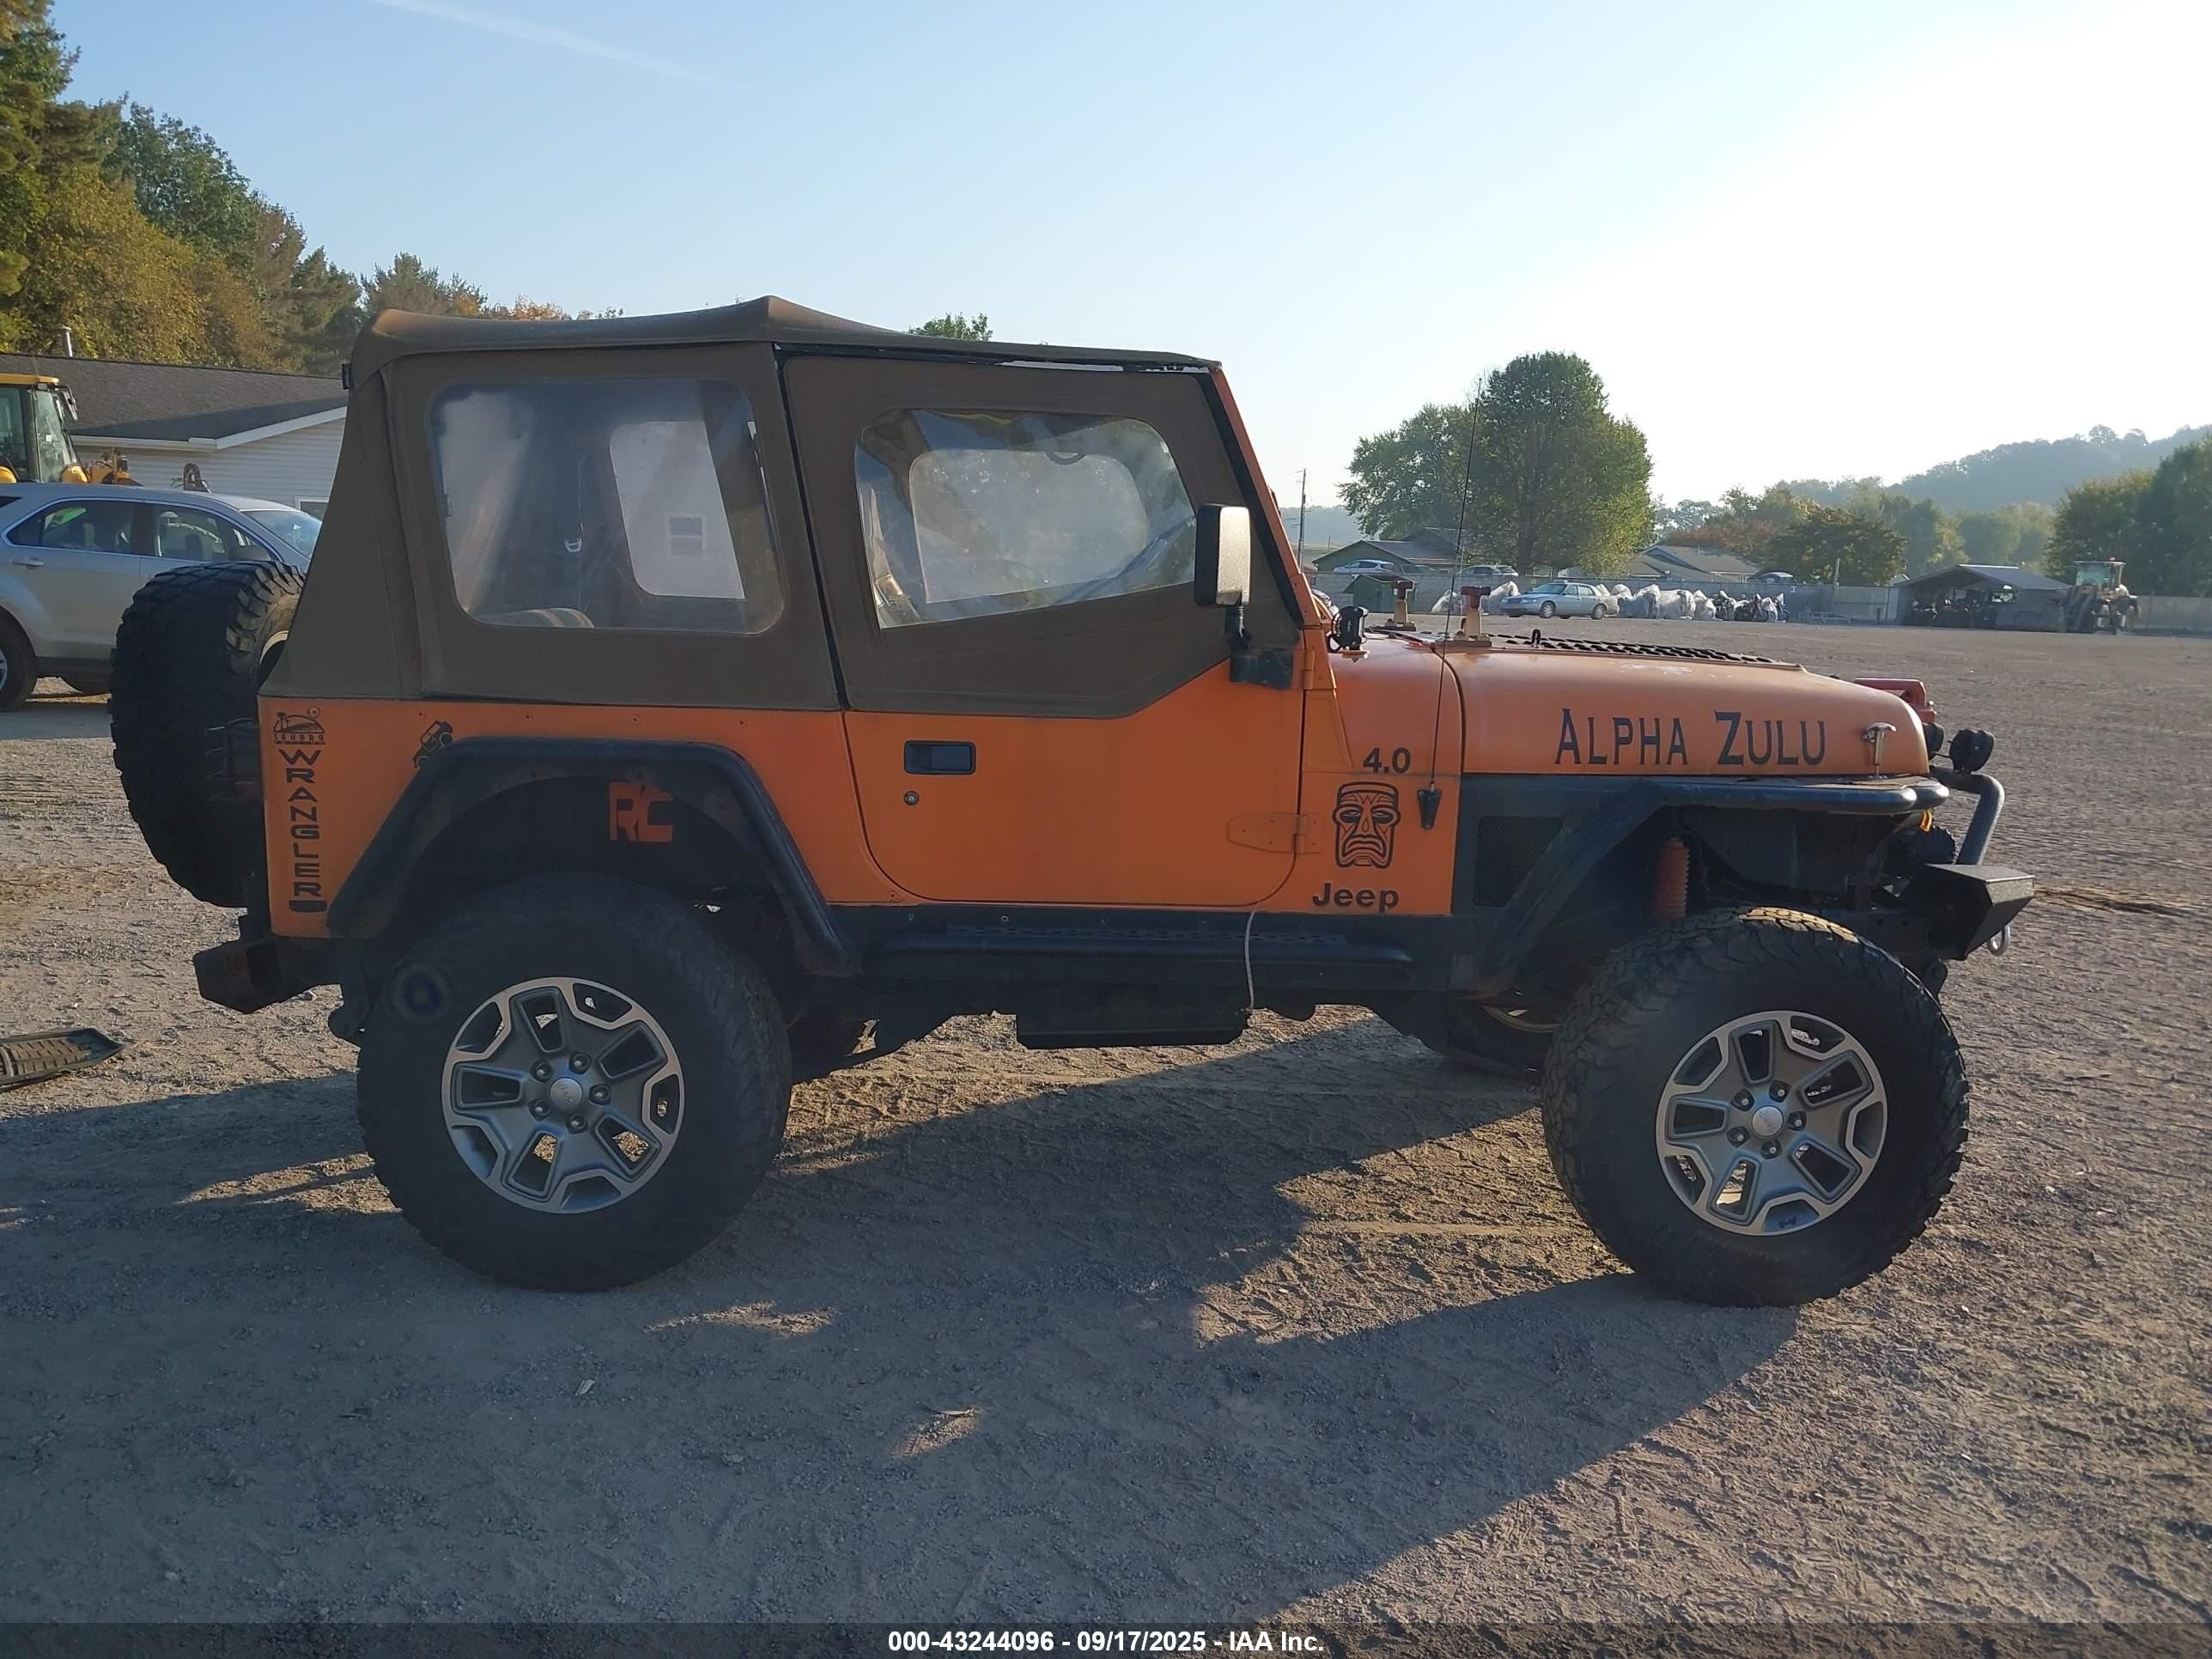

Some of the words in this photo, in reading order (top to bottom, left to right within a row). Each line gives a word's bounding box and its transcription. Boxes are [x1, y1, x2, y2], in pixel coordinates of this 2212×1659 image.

[1363, 747, 1411, 774] 4.0
[1554, 708, 1689, 765] ALPHA
[1715, 710, 1828, 767] ZULU
[278, 748, 323, 897] WRANGLER
[609, 781, 674, 843] RC
[1312, 882, 1400, 914] Jeep
